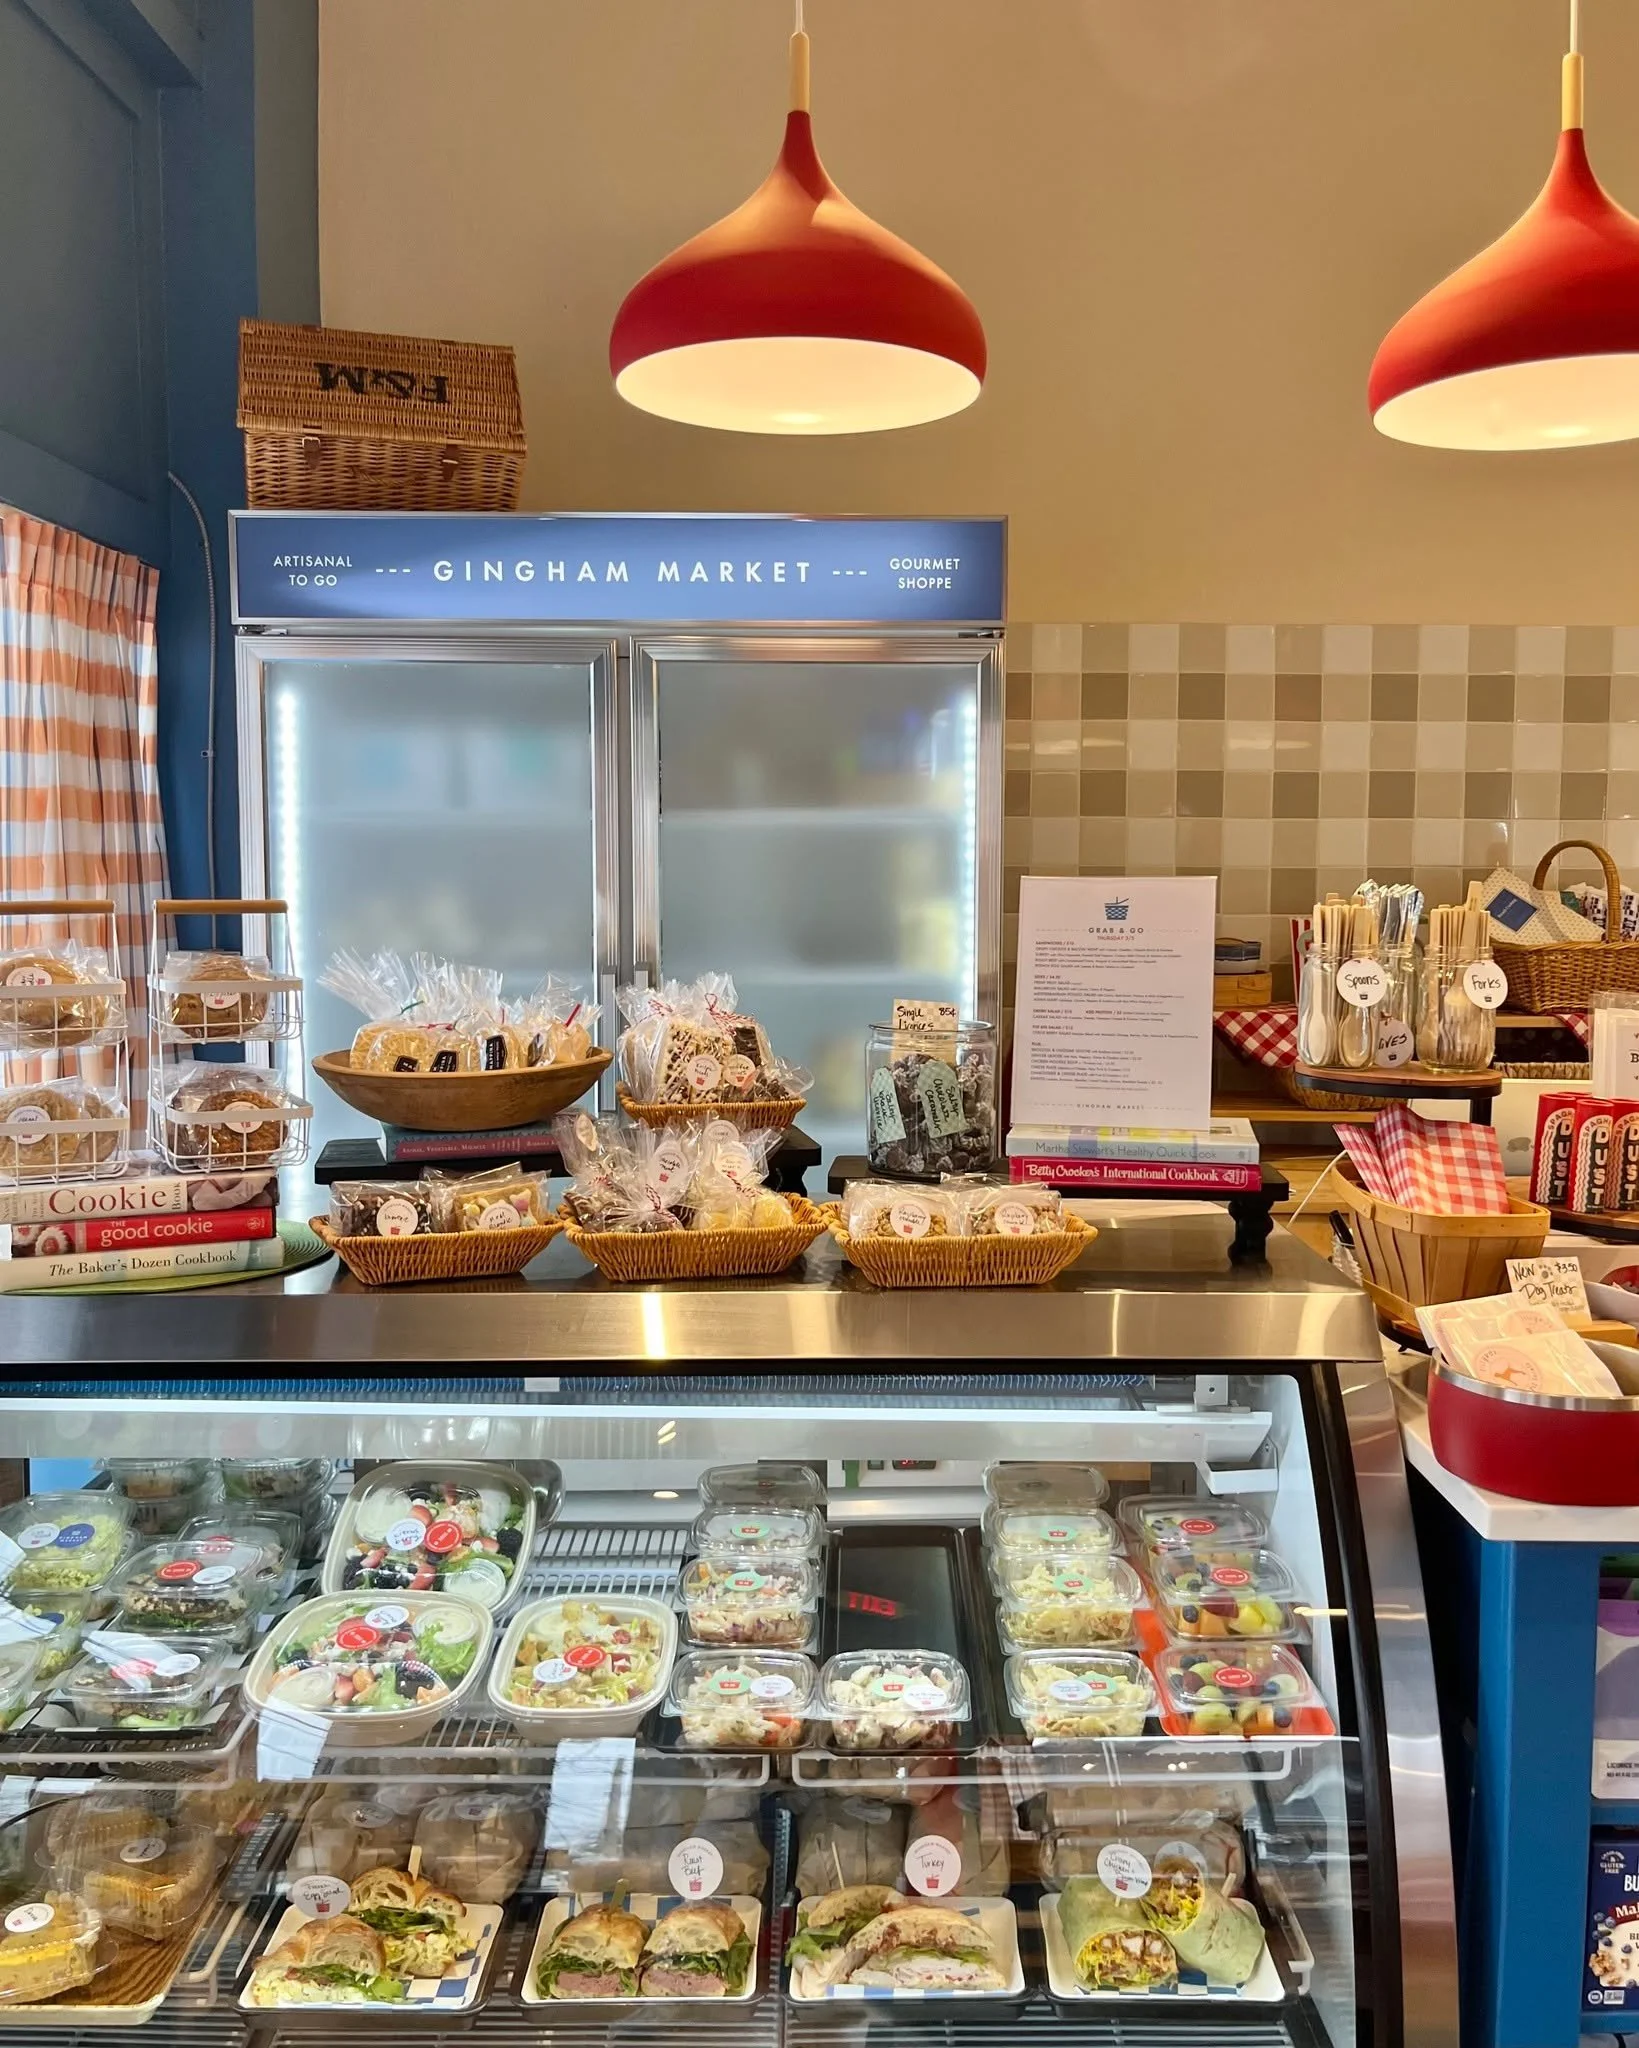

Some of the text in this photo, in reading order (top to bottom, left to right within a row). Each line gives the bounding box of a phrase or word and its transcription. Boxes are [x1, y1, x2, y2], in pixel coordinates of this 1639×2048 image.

[313, 362, 450, 403] F&M
[273, 555, 353, 567] ARTISANAL
[889, 557, 960, 570] GOURMET
[433, 560, 813, 583] GINGHAM MARKET
[289, 574, 338, 587] TO GO
[897, 576, 952, 589] SHOPPE
[1344, 974, 1380, 989] Spoons
[1471, 974, 1502, 990] Forks
[1035, 1142, 1070, 1154] Martha
[1117, 1145, 1154, 1158] Healthy
[1158, 1146, 1186, 1158] Quick
[1554, 1118, 1574, 1197] DUST
[1591, 1126, 1610, 1205] DUST
[1624, 1124, 1639, 1201] DUST
[1025, 1164, 1055, 1179] Betty
[1056, 1164, 1100, 1178] Crocker's
[1103, 1165, 1167, 1180] International
[1168, 1168, 1219, 1182] Cookbook
[48, 1185, 168, 1215] Cookie
[101, 1217, 214, 1247] good cookie
[110, 1220, 126, 1228] THE
[49, 1250, 237, 1277] The Baker's Dozen Cookbook
[1519, 1283, 1546, 1300] Dog
